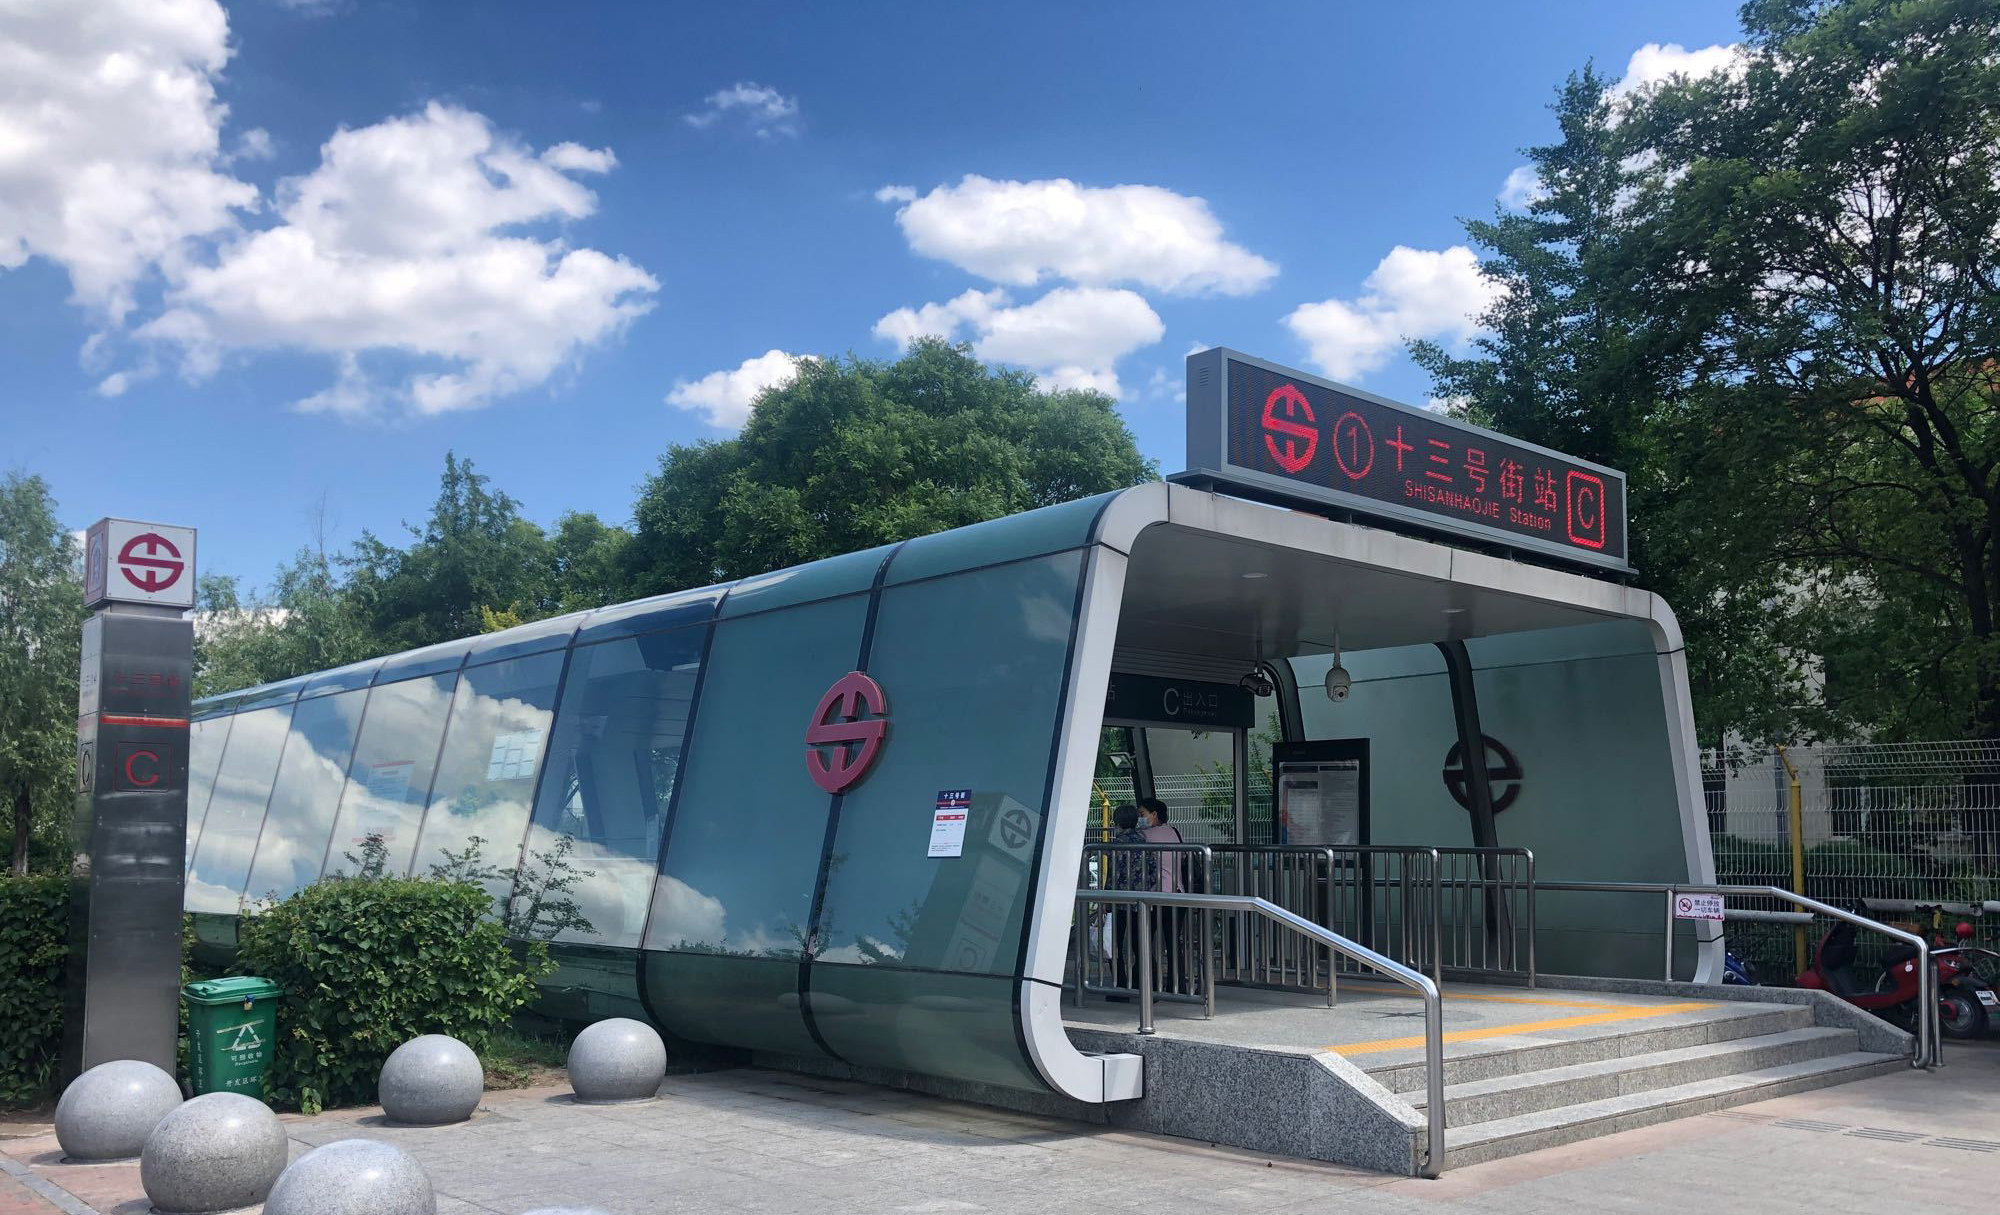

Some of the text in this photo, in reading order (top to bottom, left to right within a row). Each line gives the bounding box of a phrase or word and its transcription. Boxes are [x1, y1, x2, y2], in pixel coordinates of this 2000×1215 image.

[1385, 424, 1557, 513] 十三号街站
[1577, 487, 1594, 529] C
[1404, 479, 1551, 531] SHISANHAOJIE Station
[1164, 688, 1179, 715] C
[1183, 691, 1217, 708] 出入口
[126, 750, 160, 787] C
